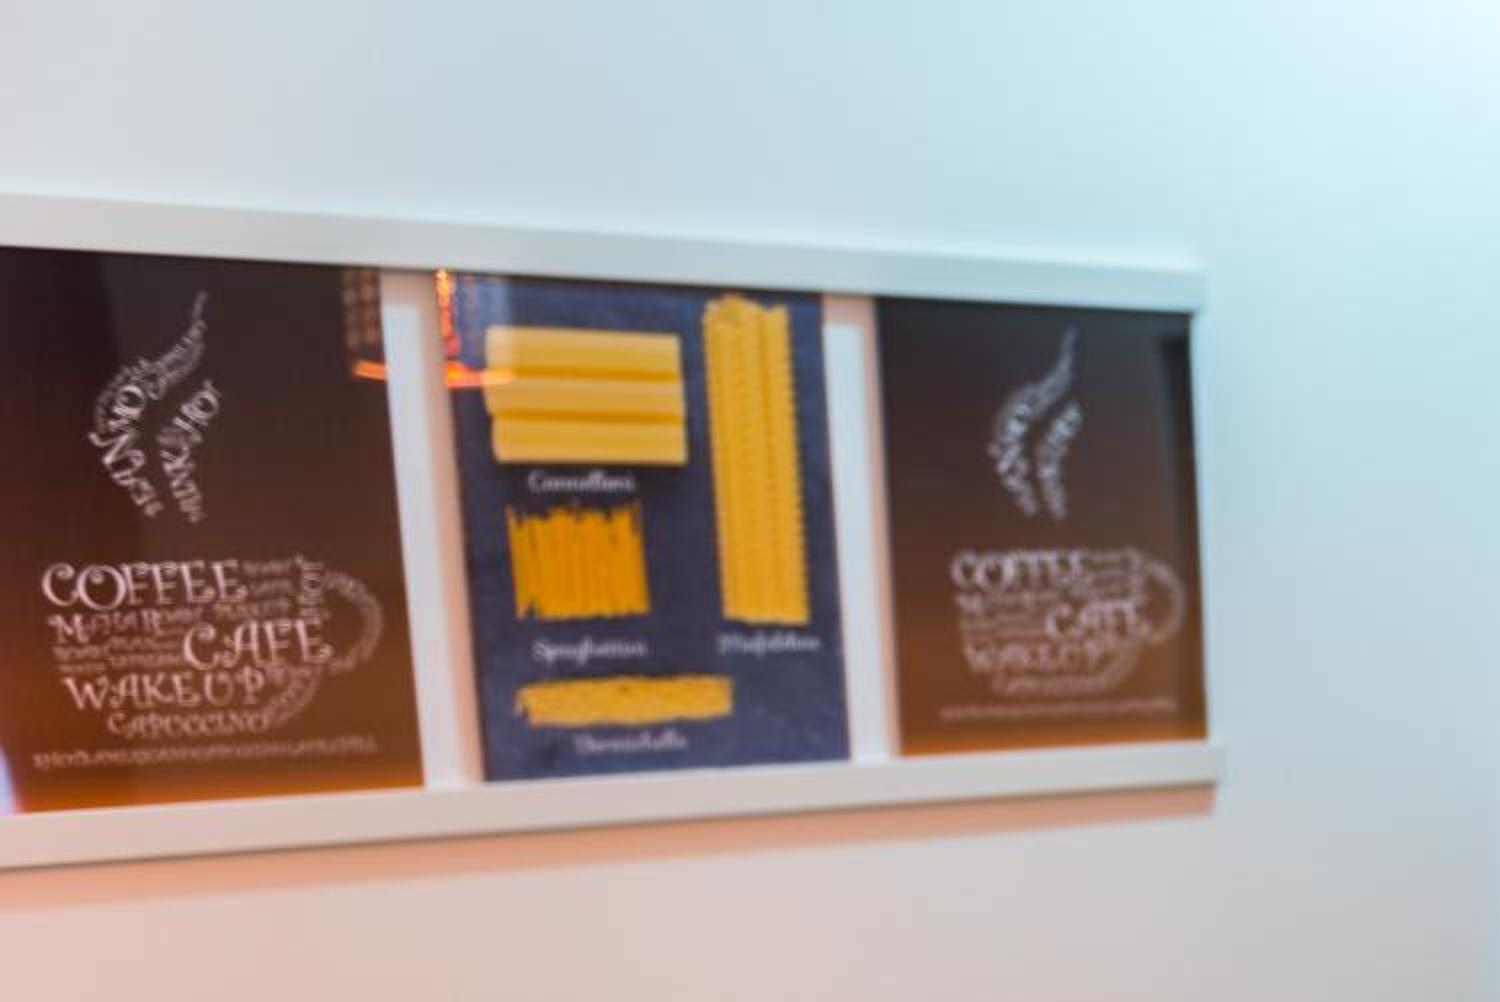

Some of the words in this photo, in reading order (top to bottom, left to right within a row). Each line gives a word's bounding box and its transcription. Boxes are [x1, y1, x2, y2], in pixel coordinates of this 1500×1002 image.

[41, 559, 248, 610] COFFEE
[952, 551, 1090, 590] COFFEE
[182, 617, 336, 670] CAFE
[62, 671, 201, 711] WAKE
[205, 666, 266, 706] UP
